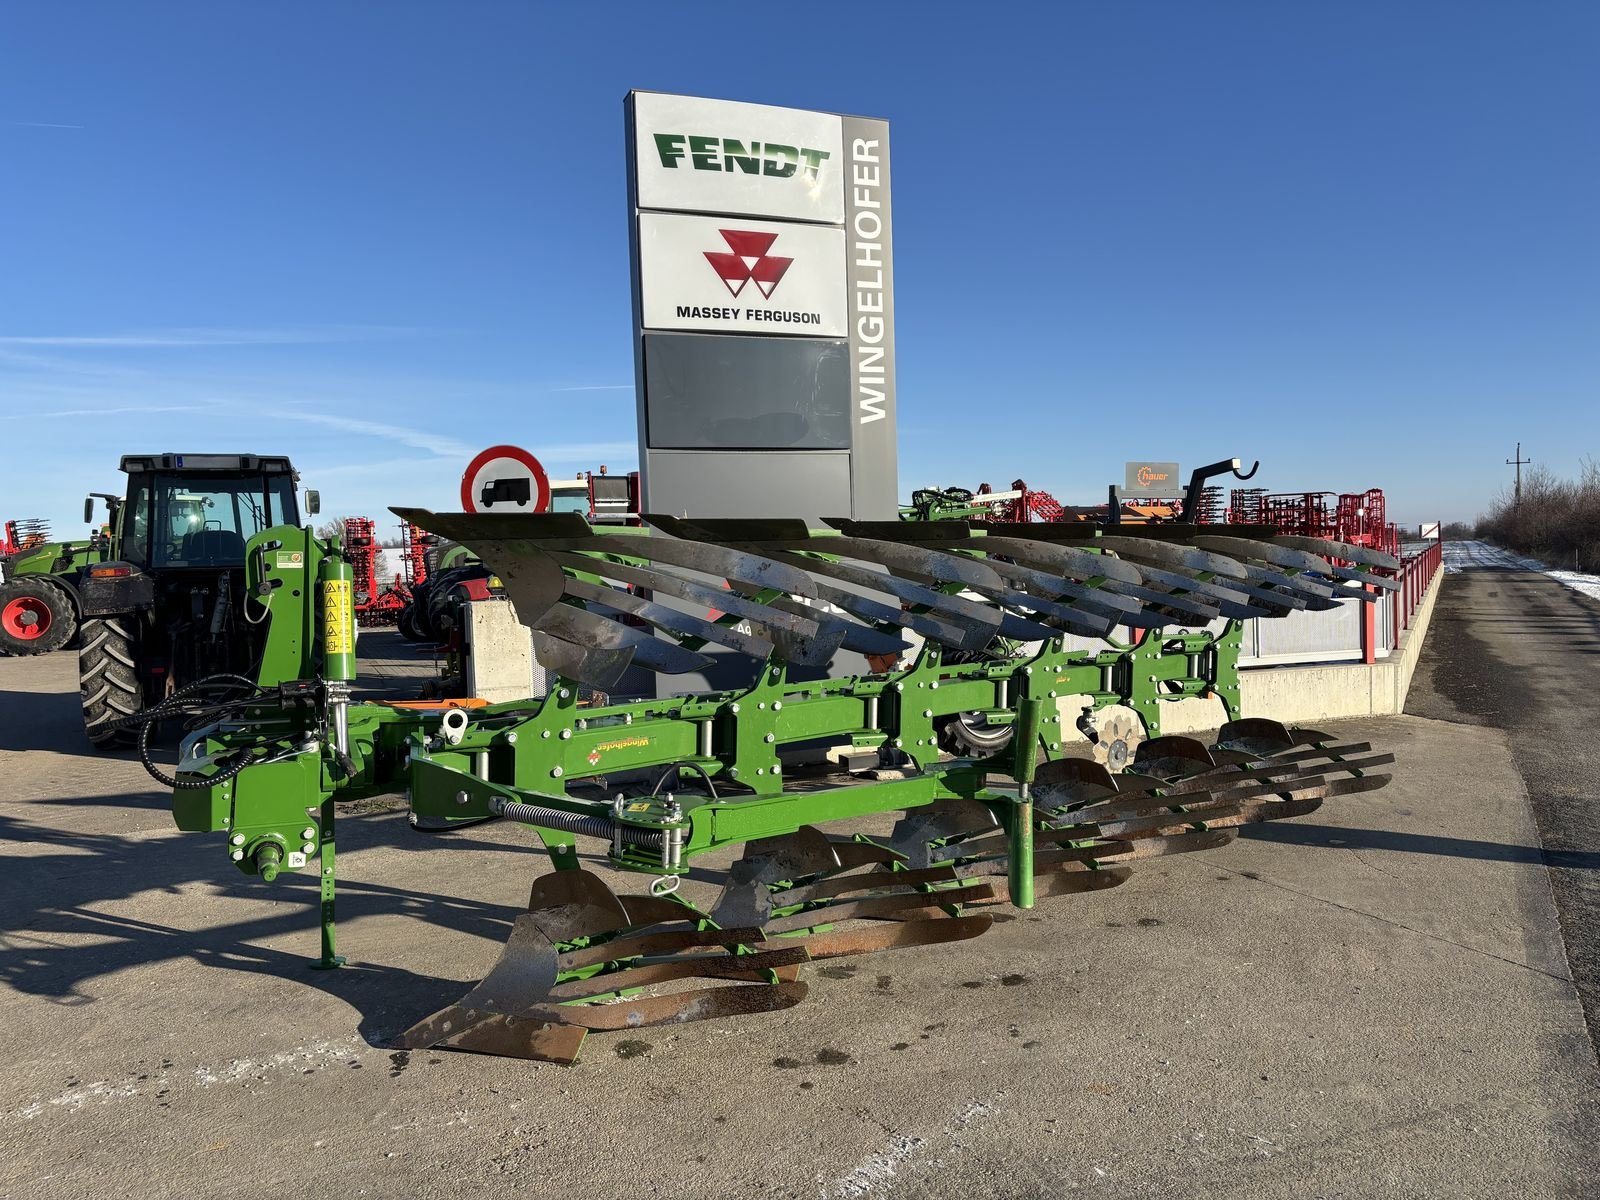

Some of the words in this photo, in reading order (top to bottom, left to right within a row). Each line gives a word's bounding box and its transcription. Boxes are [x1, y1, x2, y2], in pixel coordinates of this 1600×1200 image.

[653, 133, 830, 182] FENDT
[852, 138, 886, 425] WINGELHOFER
[676, 306, 741, 320] MASSEY
[746, 309, 821, 325] FERGUSON
